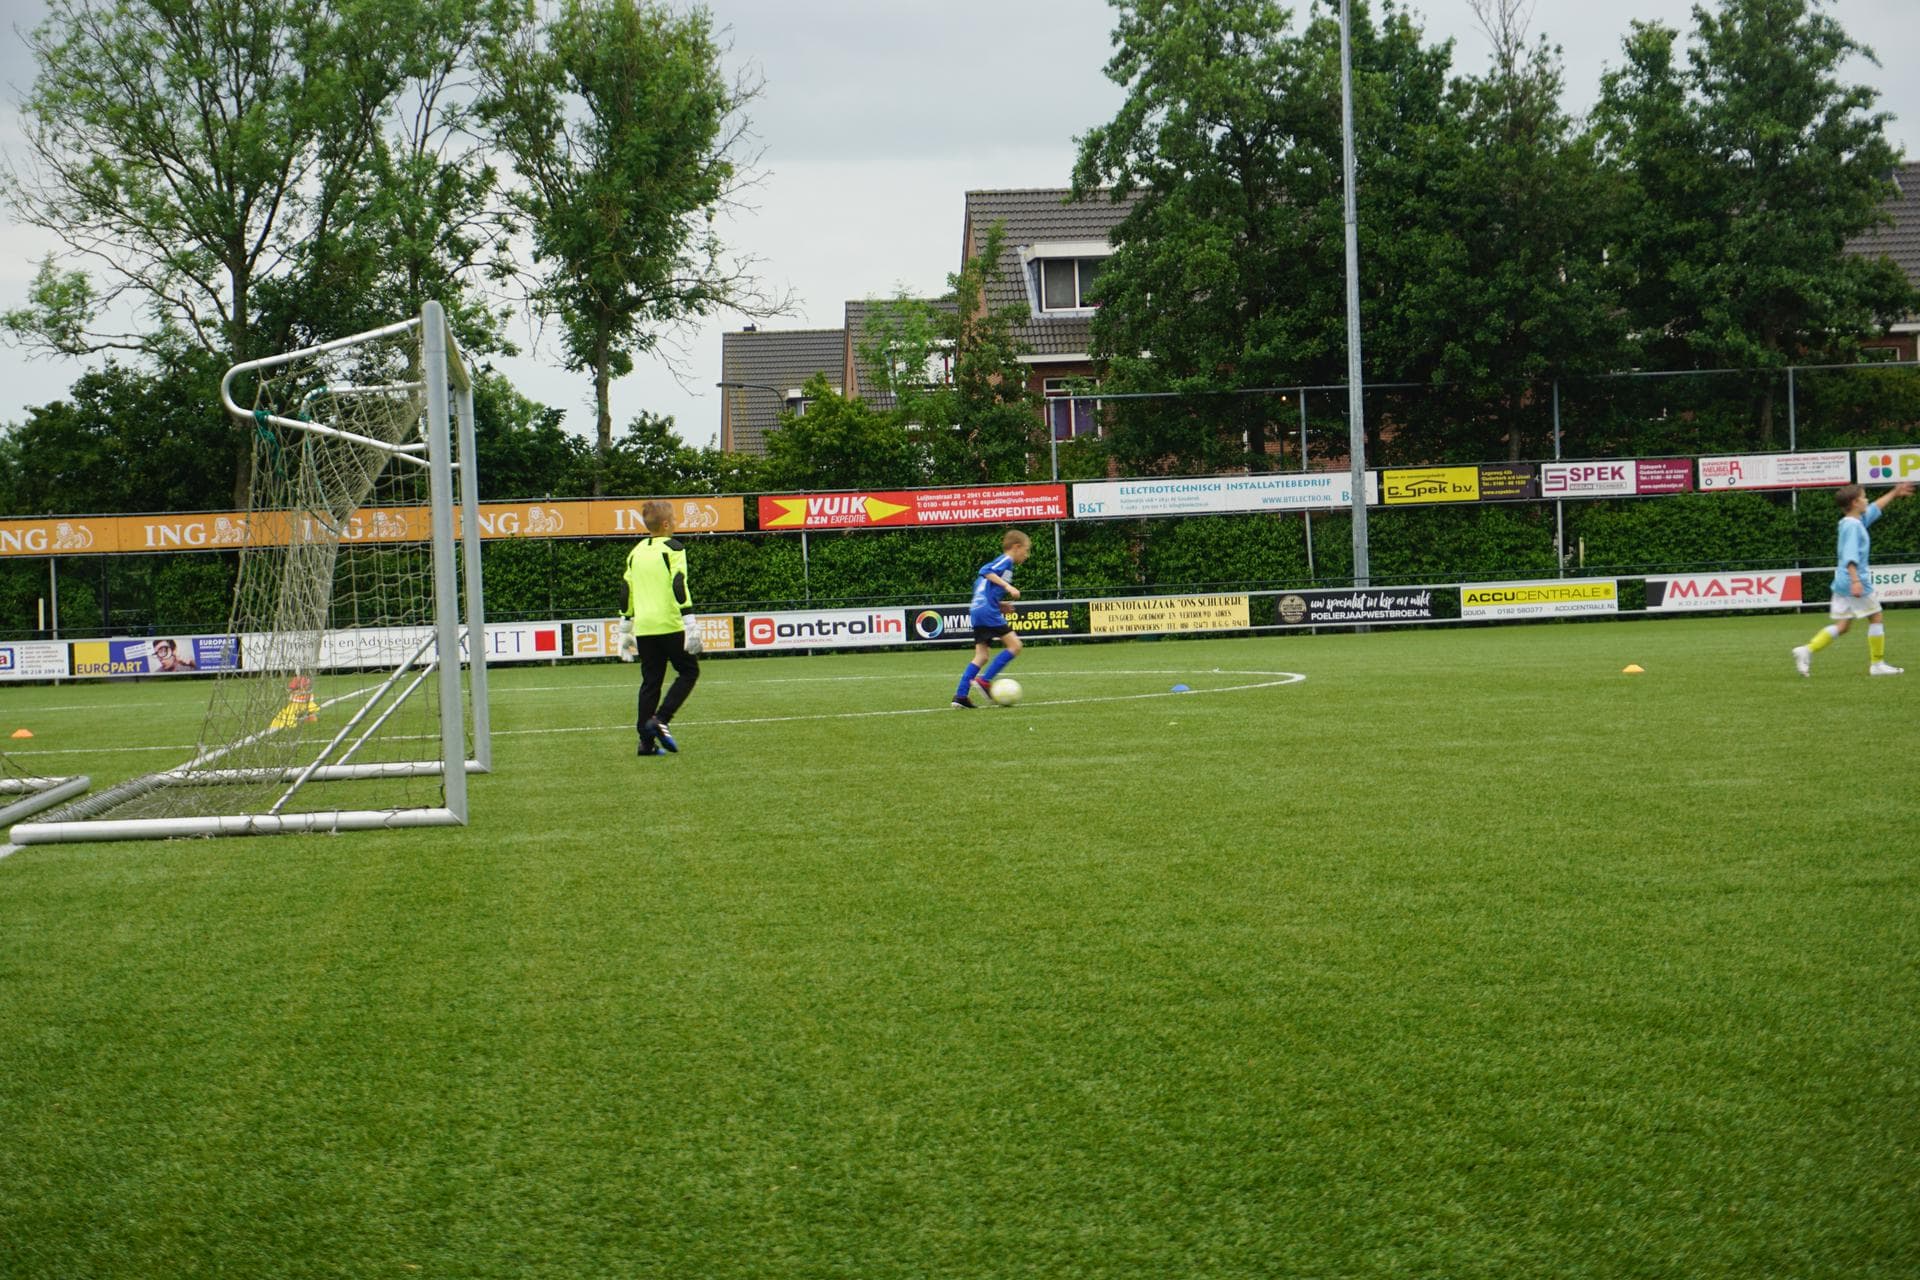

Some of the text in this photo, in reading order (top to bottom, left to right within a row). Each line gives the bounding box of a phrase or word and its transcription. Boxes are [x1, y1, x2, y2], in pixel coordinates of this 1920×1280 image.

[1569, 465, 1625, 482] SPEK
[1120, 478, 1332, 495] ELECTROTECHNISCH INSTALLATIEBEDRIJF
[1404, 479, 1448, 498] Spek
[1452, 483, 1475, 493] b.v.
[808, 496, 867, 515] VUIK
[1078, 501, 1104, 513] B&T
[614, 509, 650, 531] IN
[806, 514, 866, 525] &ZN EXPEDITIE
[917, 505, 1063, 521] WWW.VUIK-EXPEDITIE.NL
[0, 528, 48, 551] NG
[144, 524, 206, 546] ING
[1870, 571, 1907, 585] isser
[1669, 576, 1777, 598] MARK
[1467, 587, 1601, 603] ACCUCENTRALE
[1678, 598, 1768, 606] KOZIJNTECHNIEK
[943, 614, 974, 628] MYM
[1027, 611, 1046, 620] 580
[1050, 610, 1069, 619] 522
[1311, 610, 1431, 621] POELIERJAAPWESTBROEK.NL
[576, 625, 598, 633] CN
[695, 619, 729, 630] ERK
[750, 614, 902, 645] Controlin
[701, 630, 729, 641] ING
[338, 640, 354, 648] en
[76, 661, 142, 674] EUROPART
